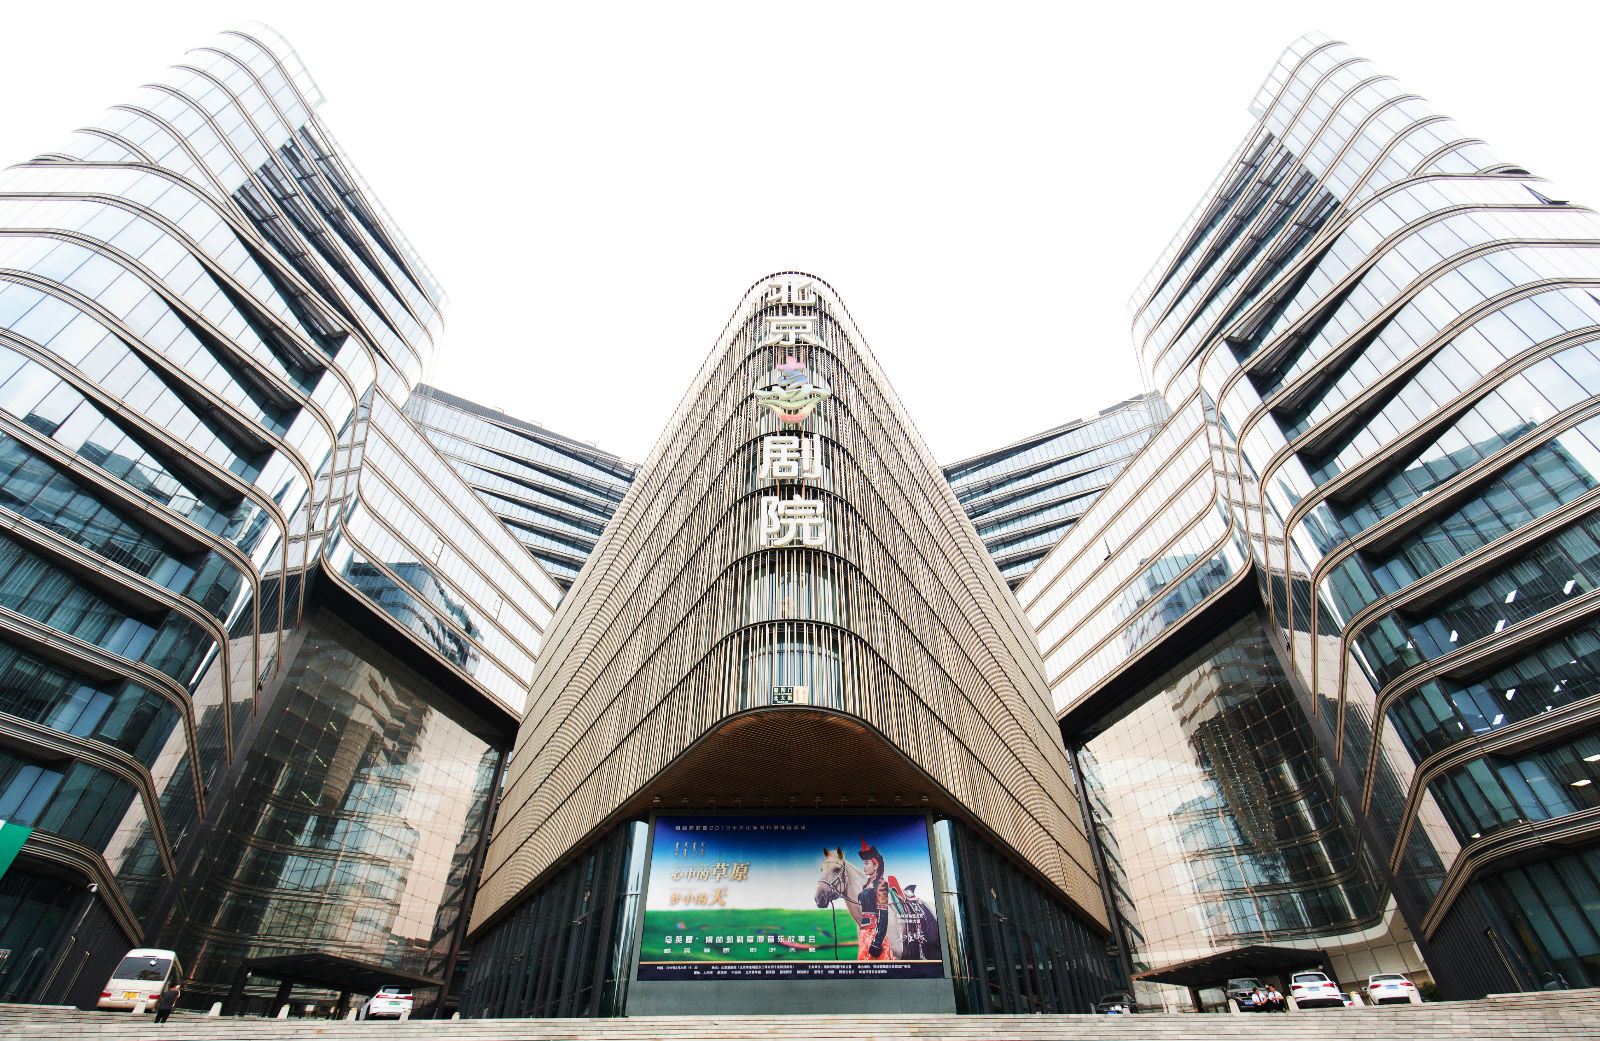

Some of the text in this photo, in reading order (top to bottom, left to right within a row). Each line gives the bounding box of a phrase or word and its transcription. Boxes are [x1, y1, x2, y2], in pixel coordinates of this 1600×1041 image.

[671, 861, 751, 882] 心中的草原
